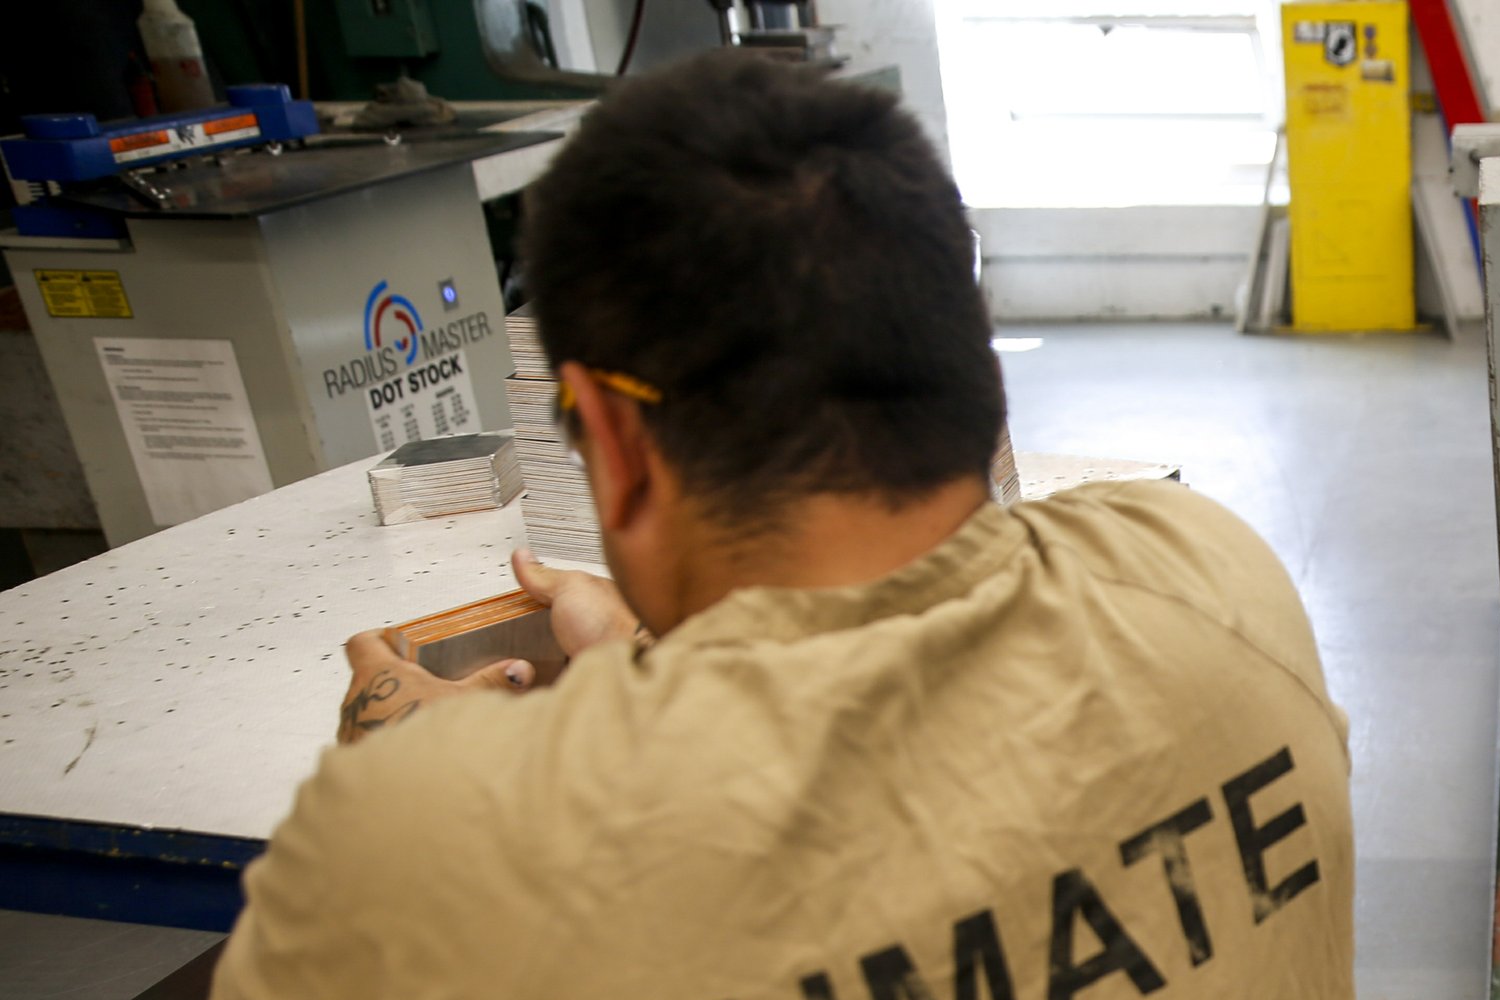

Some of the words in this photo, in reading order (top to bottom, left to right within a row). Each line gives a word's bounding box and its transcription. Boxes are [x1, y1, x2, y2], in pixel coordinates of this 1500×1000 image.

[323, 346, 398, 399] RADIUS
[421, 311, 492, 359] MASTER
[369, 378, 403, 410] DOT
[408, 354, 463, 393] STOCK
